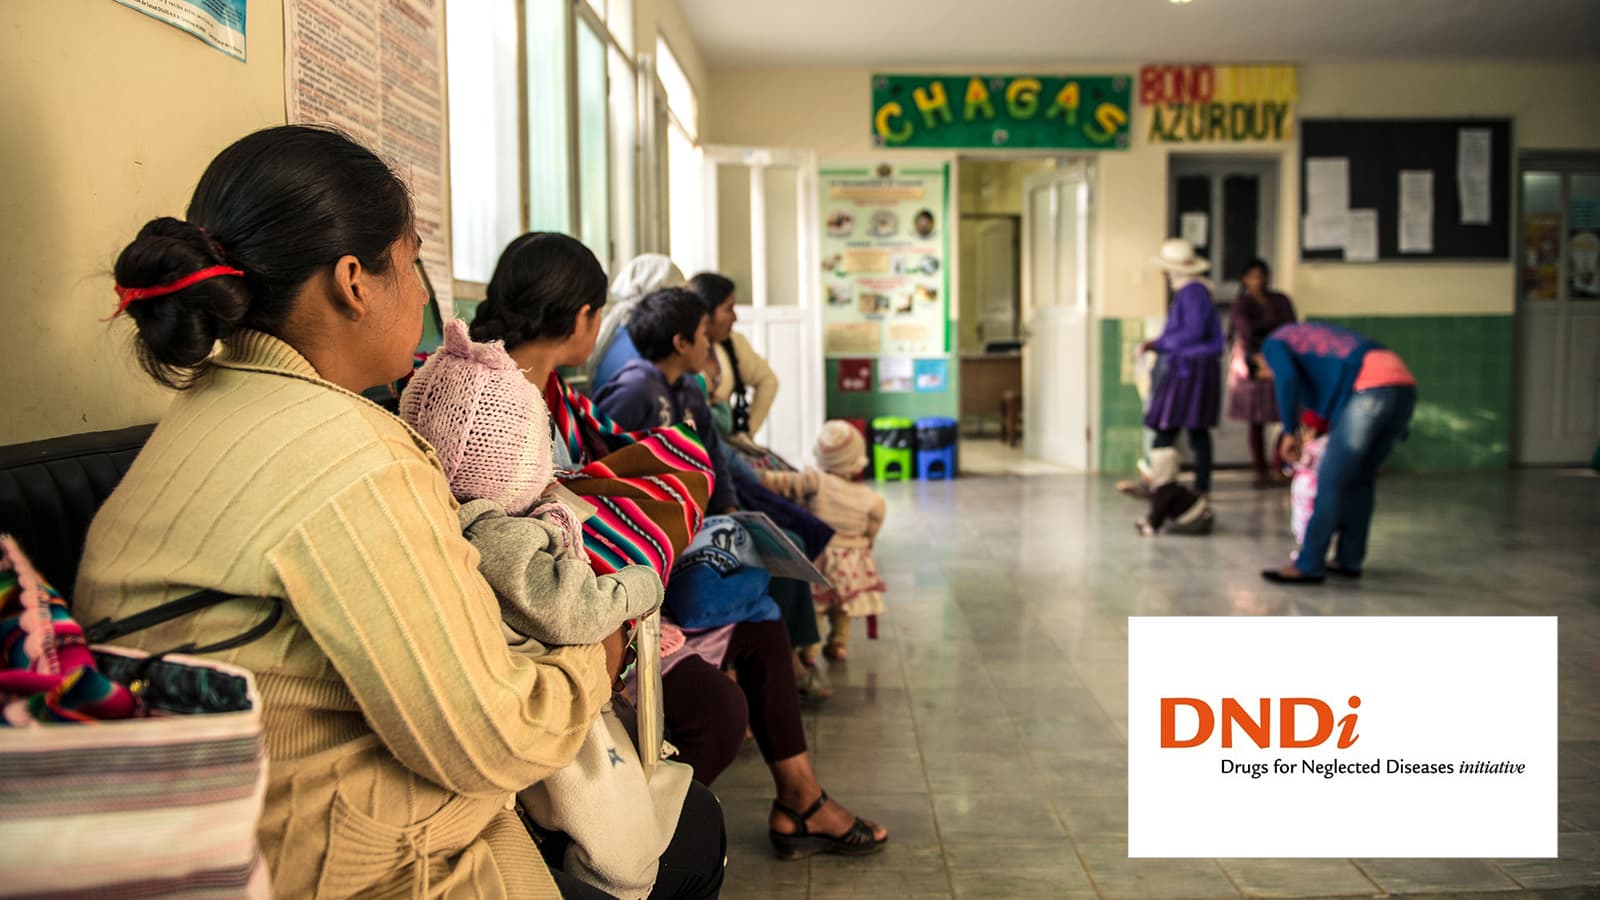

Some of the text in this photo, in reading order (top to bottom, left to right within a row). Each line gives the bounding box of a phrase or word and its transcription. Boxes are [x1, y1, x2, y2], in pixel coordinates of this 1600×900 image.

[1140, 64, 1215, 105] BONO
[875, 76, 1128, 144] CHAGAS
[1148, 101, 1289, 142] AZURDUY
